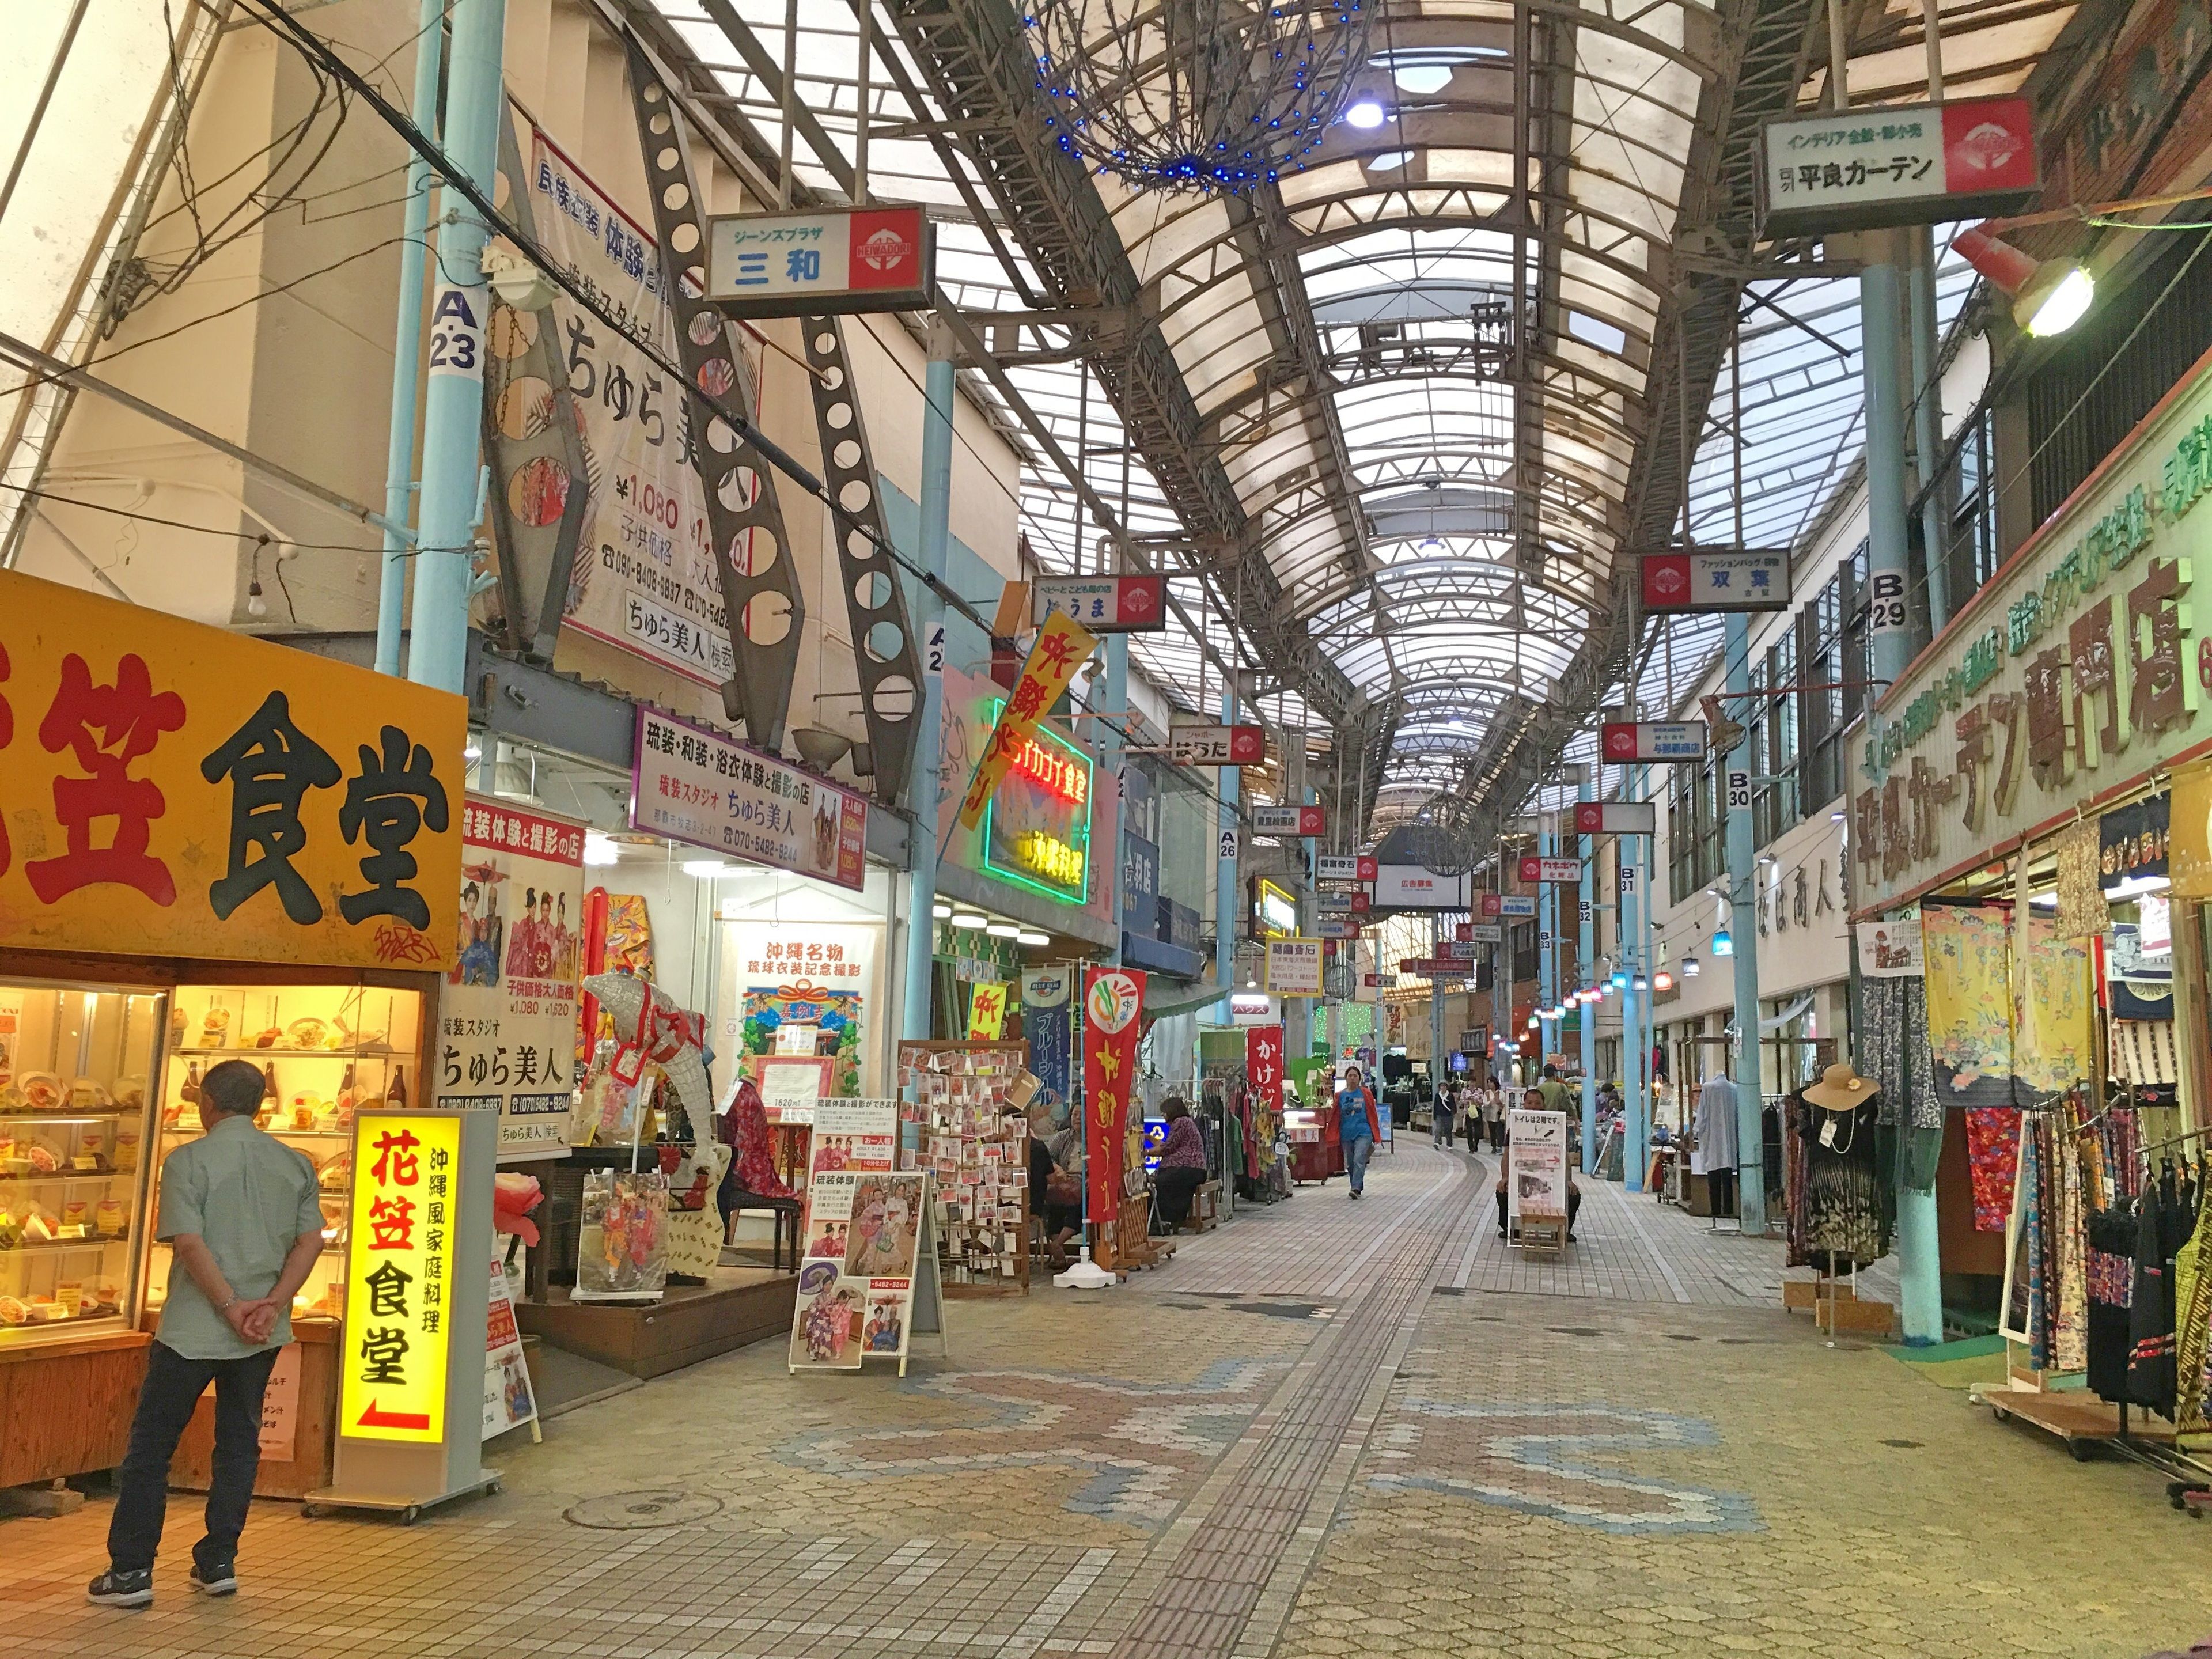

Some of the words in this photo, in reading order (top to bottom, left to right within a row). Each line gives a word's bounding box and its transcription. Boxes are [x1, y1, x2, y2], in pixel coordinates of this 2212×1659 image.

[734, 226, 824, 246] ジーンズプラザ
[856, 242, 911, 262] HEIWADORI
[736, 249, 820, 286] 三和
[430, 333, 476, 369] 23
[1874, 574, 1904, 599] B
[1873, 603, 1905, 628] 29
[630, 599, 705, 661] ちゅら美人
[1729, 772, 1748, 787] B
[658, 774, 719, 811] 琉装スタジオ
[1729, 791, 1749, 806] 30
[727, 789, 796, 838] ちゅら美人
[733, 828, 798, 863] 070-5482-9244
[1221, 832, 1235, 843] A
[1220, 846, 1235, 857] 26
[1622, 868, 1634, 879] B
[1620, 881, 1634, 892] 31
[1580, 901, 1590, 910] B
[1579, 912, 1591, 921] 32
[1540, 931, 1550, 940] B
[1540, 941, 1550, 949] 33
[766, 941, 844, 963] 沖縄名物
[747, 960, 862, 978] 琉球衣装記念撮影
[507, 980, 543, 998] 子供価格
[543, 983, 574, 1001] 大人価格
[510, 1000, 539, 1015] ¥1,080
[545, 1003, 569, 1017] ¥1,620
[443, 1017, 501, 1037] 琉装スタジオ
[442, 1044, 563, 1088] ちゅら美人
[502, 1126, 542, 1141] ちゅら美人
[421, 1146, 449, 1334] 沖縄風家庭料理
[361, 1129, 421, 1386] 花笠食堂
